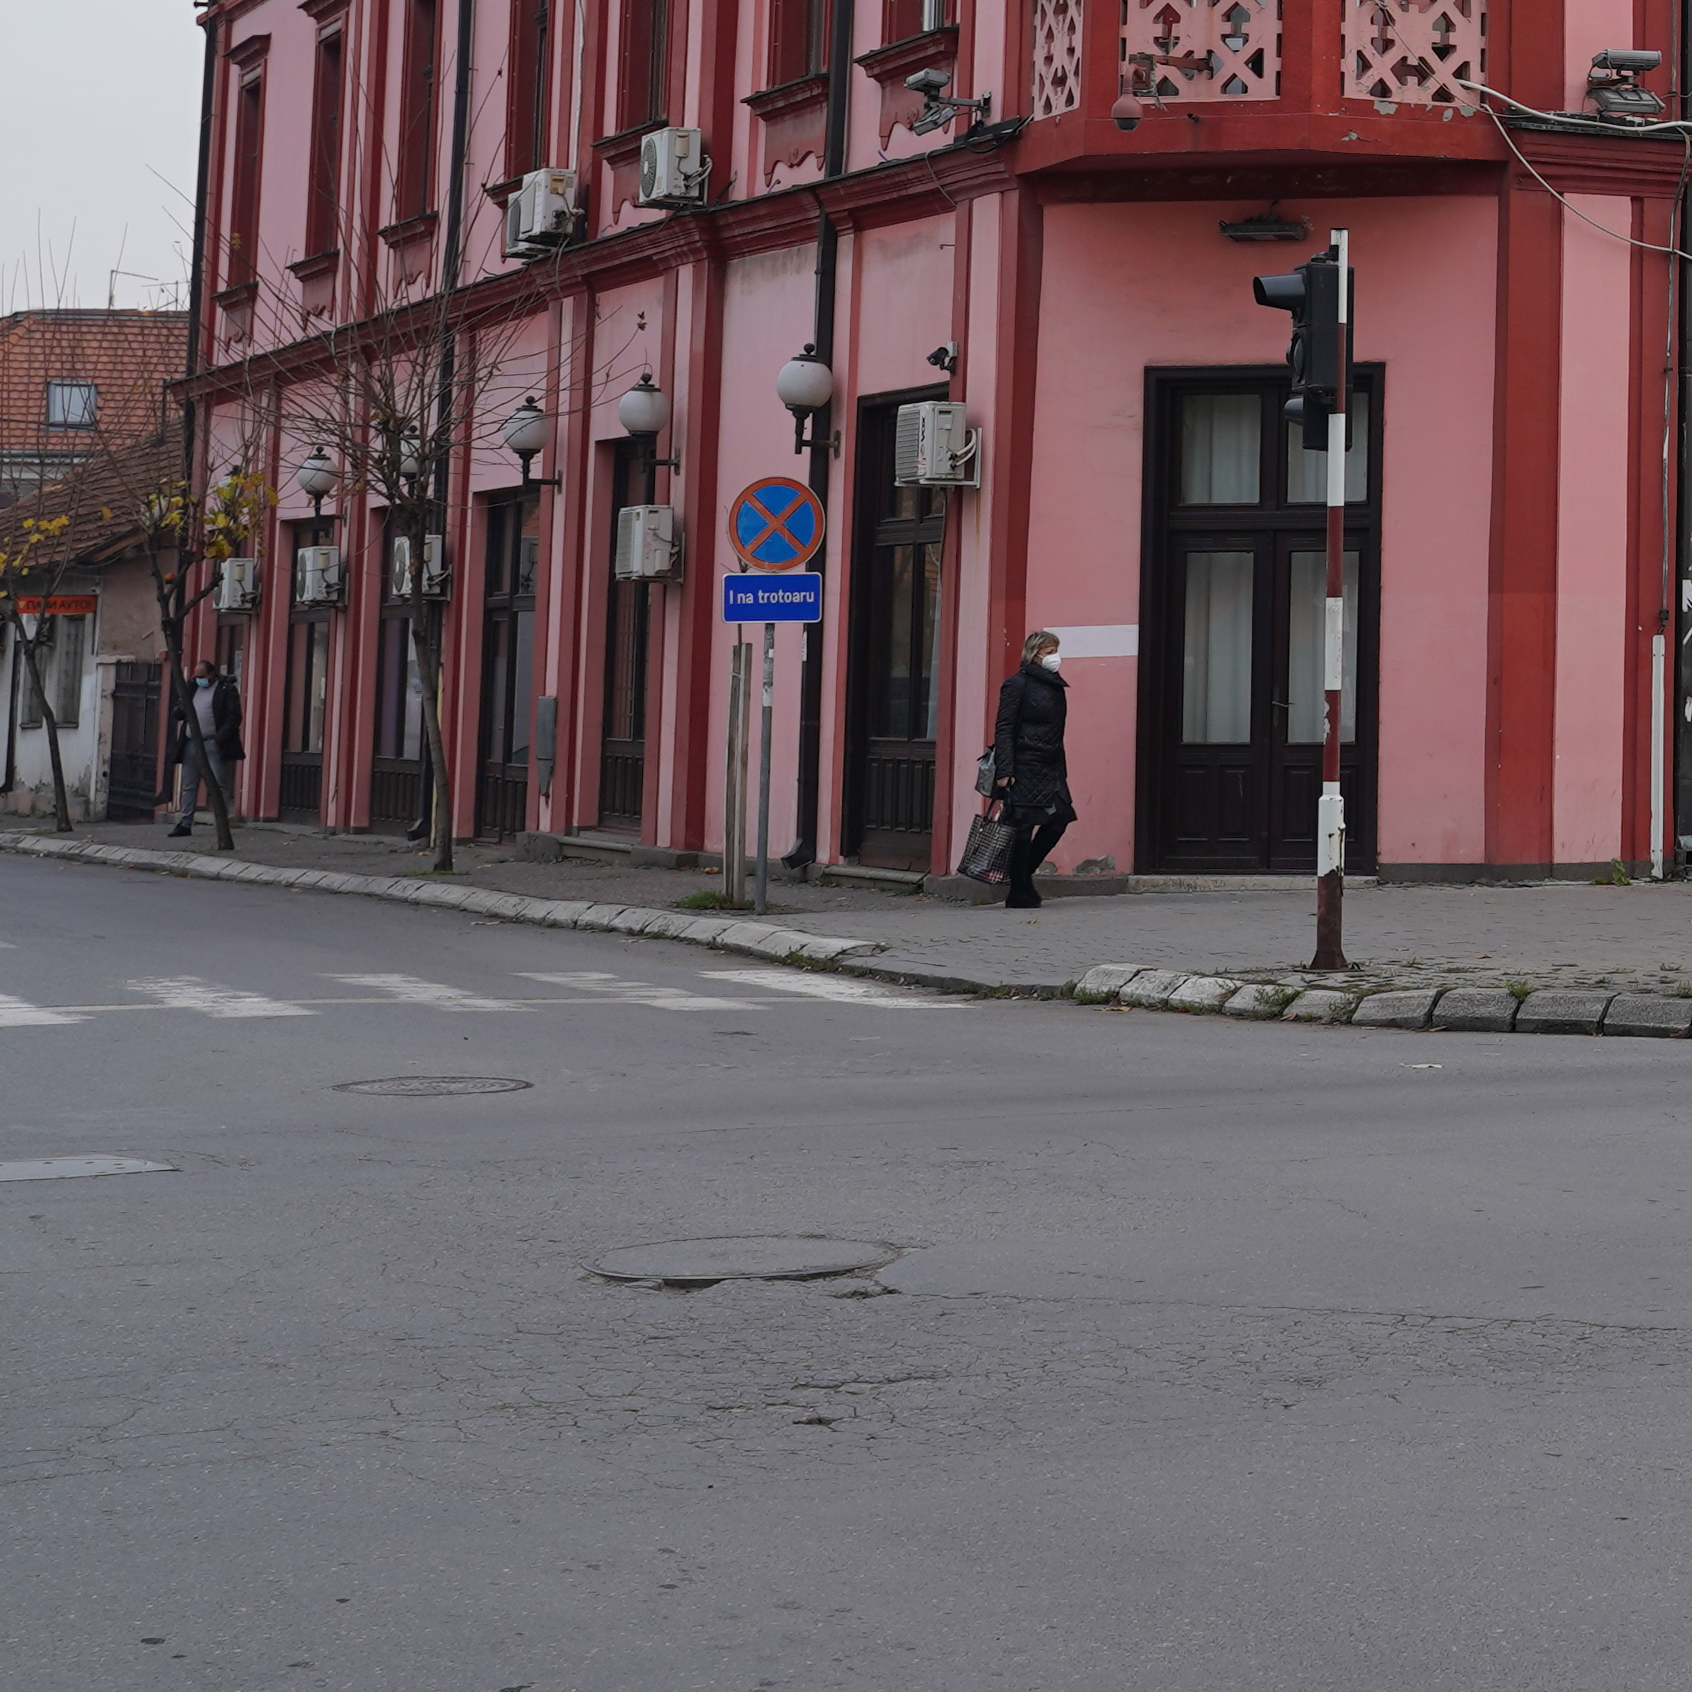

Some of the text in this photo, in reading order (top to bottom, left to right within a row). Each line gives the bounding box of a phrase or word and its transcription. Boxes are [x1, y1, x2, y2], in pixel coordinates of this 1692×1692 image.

[729, 589, 814, 604] I na trotoaru
